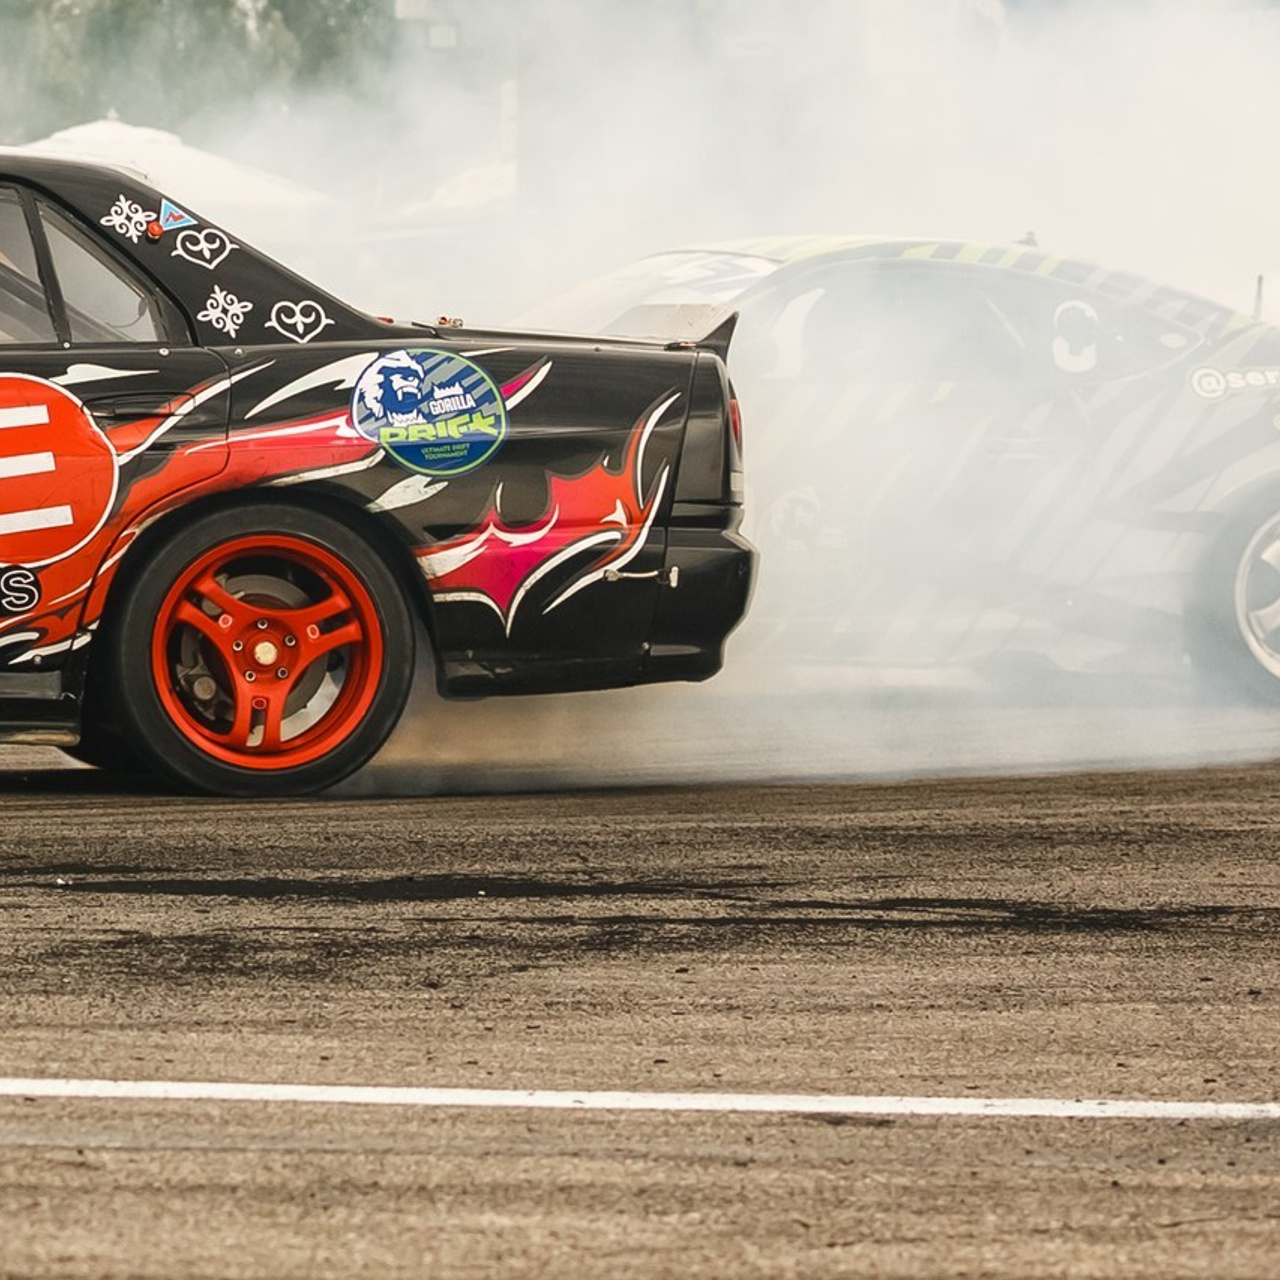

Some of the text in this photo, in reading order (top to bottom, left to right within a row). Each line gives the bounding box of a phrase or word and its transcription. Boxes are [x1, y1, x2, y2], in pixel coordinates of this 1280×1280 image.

[429, 393, 477, 415] GORILLA
[421, 444, 451, 454] ULTIMATE
[424, 450, 468, 460] TOURNAMENT
